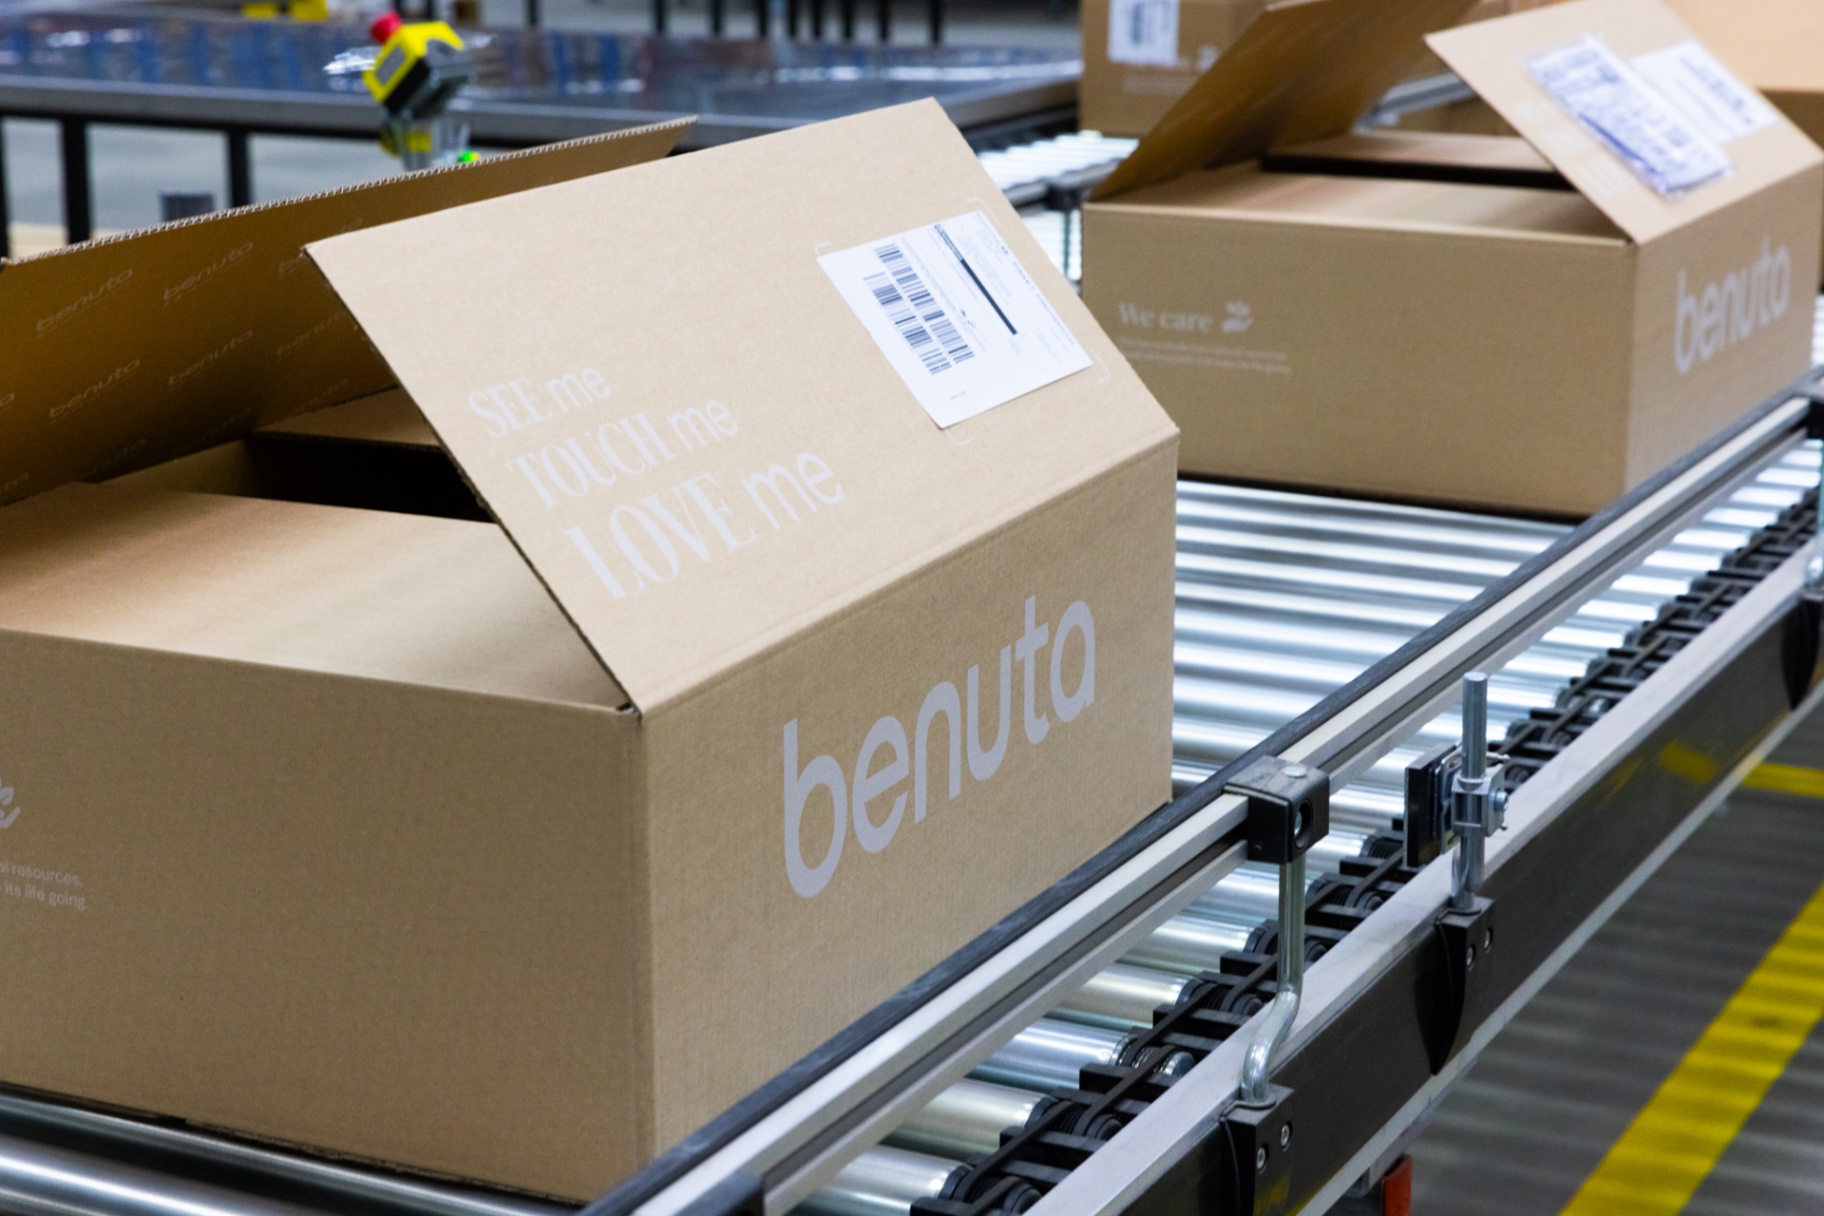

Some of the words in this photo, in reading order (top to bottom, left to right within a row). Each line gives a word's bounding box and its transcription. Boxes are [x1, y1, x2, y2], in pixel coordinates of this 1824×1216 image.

[1118, 302, 1153, 327] We
[1159, 311, 1213, 334] care
[1674, 234, 1791, 374] benuta
[467, 378, 554, 438] SEE
[545, 366, 611, 414] me
[504, 411, 676, 511] TOUCH
[666, 399, 739, 453] me
[562, 473, 758, 601] LOVE
[740, 451, 844, 532] me
[783, 595, 1096, 898] benuta
[4, 880, 22, 898] its
[25, 882, 46, 902] life
